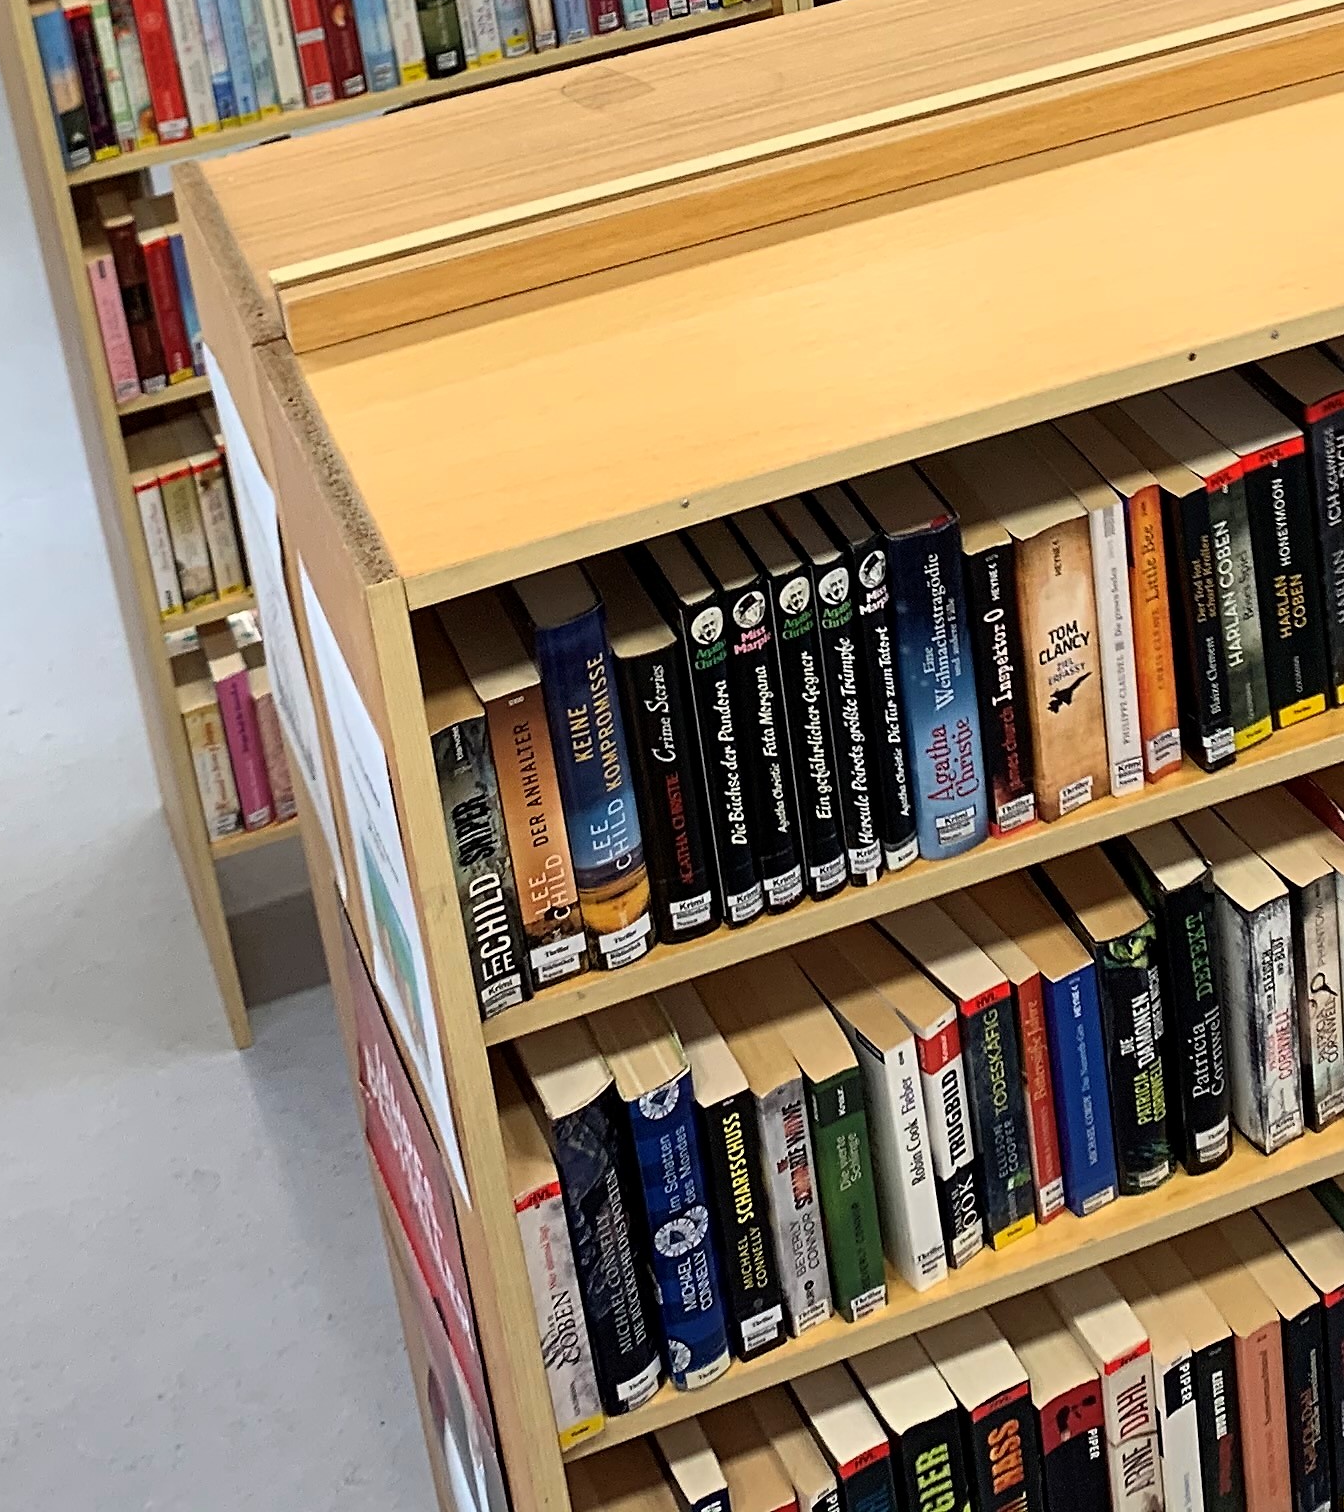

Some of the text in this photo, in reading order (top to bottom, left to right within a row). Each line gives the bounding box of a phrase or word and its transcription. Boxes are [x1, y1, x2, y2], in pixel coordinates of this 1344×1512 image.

[1271, 478, 1292, 567] HONEYMOON
[1326, 496, 1342, 527] ICH
[1212, 519, 1245, 669] HARLAN COBEN
[1274, 574, 1293, 639] HARLAN
[1290, 573, 1308, 629] COBEN
[922, 552, 958, 712] Weihnachtstragödie
[1038, 630, 1091, 666] CLANCY
[1046, 620, 1079, 645] TOM
[586, 650, 624, 793] KOMPROMISSE
[711, 678, 736, 743] Pandora
[754, 664, 776, 727] Morgana
[566, 701, 592, 765] KEINE
[804, 701, 833, 797] gefährlicher
[924, 723, 956, 803] Agatha
[954, 717, 980, 799] Christie
[511, 720, 549, 848] DER ANHALTER
[589, 817, 612, 867] LEE
[613, 796, 634, 872] CHILD
[854, 793, 875, 846] Hercule
[468, 872, 517, 982] LEE CHILD
[1184, 912, 1214, 1002] DEFEKT
[982, 1008, 1009, 1118] TODESKÄFIG
[1120, 1036, 1135, 1057] DIE
[1188, 1021, 1211, 1099] Patricia
[1205, 1004, 1226, 1096] Cornwell
[1273, 1007, 1294, 1080] CORNWELL
[900, 1075, 927, 1187] Robin Cook Fieber
[941, 1068, 967, 1166] TRUGBILD
[1133, 1069, 1152, 1126] PATRICIA
[659, 1133, 681, 1197] Schatten
[673, 1124, 697, 1206] des Mondes
[722, 1110, 754, 1226] SCHARFSCHUSS
[691, 1252, 714, 1313] CONNELLY
[742, 1233, 760, 1291] MICHAEL
[748, 1225, 770, 1289] CONNELLY
[788, 1220, 807, 1279] BEVERLY
[676, 1256, 698, 1313] MICHAEL
[1179, 1363, 1193, 1411] PIPER
[1087, 1427, 1100, 1461] PIPER
[1116, 1374, 1156, 1498] ARNE DAHL
